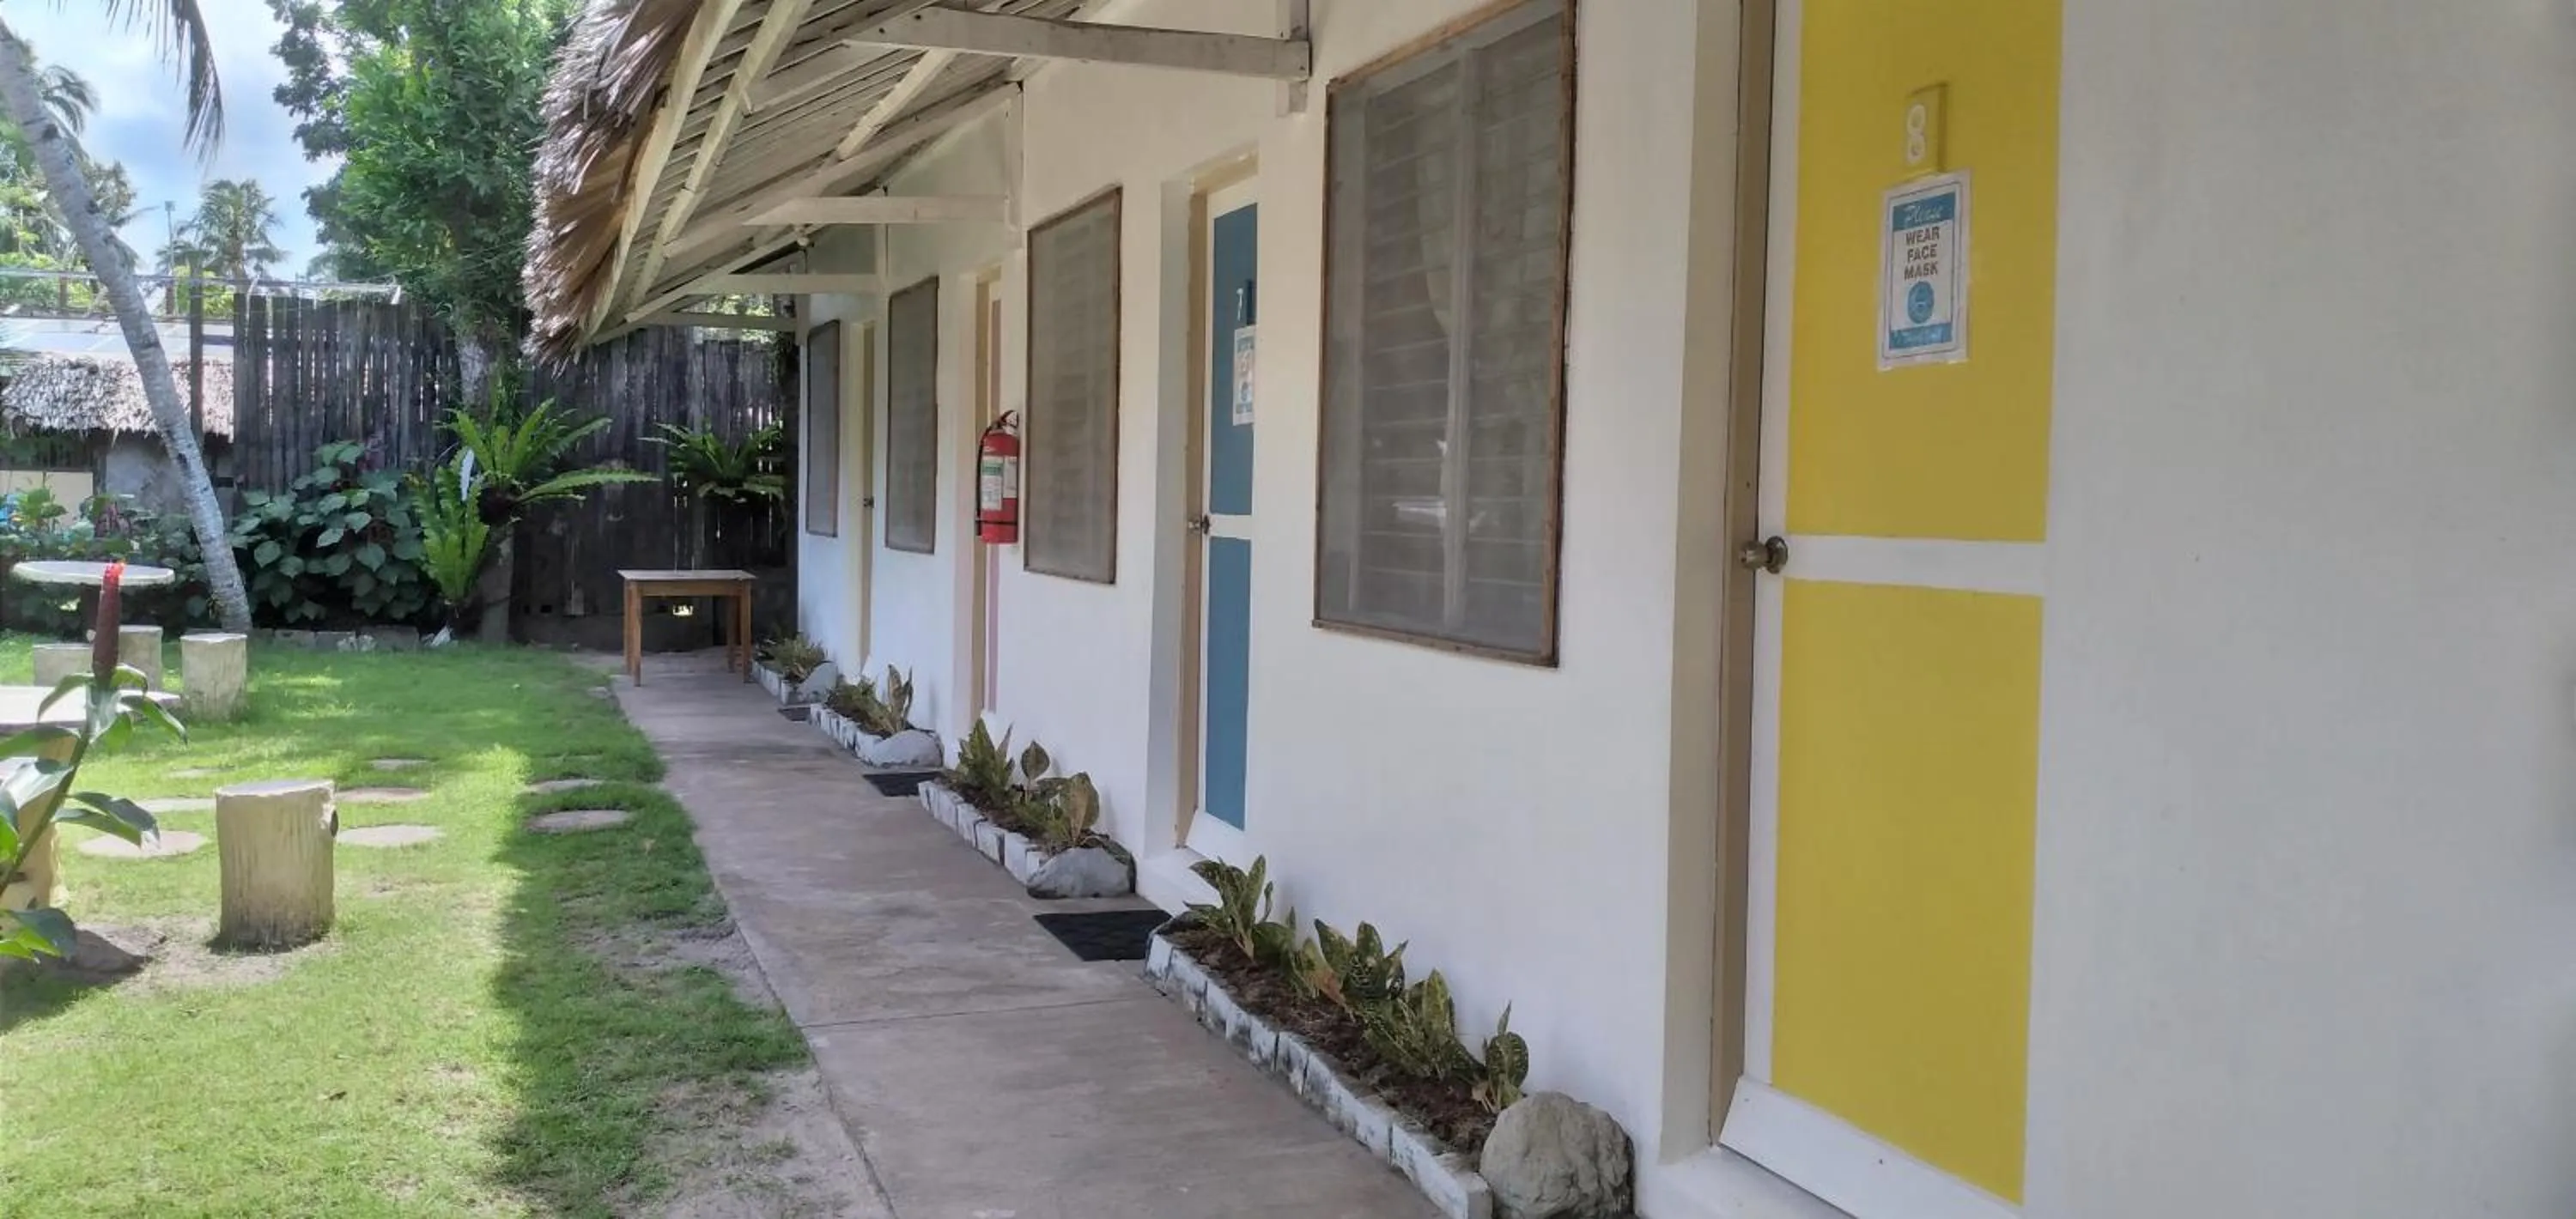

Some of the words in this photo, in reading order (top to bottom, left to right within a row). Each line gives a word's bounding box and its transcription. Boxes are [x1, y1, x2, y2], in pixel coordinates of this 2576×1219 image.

[1906, 103, 1927, 166] 8
[1905, 226, 1941, 246] WEAR
[1906, 243, 1938, 263] FACE
[1904, 261, 1939, 281] MASK
[1236, 288, 1244, 322] 7
